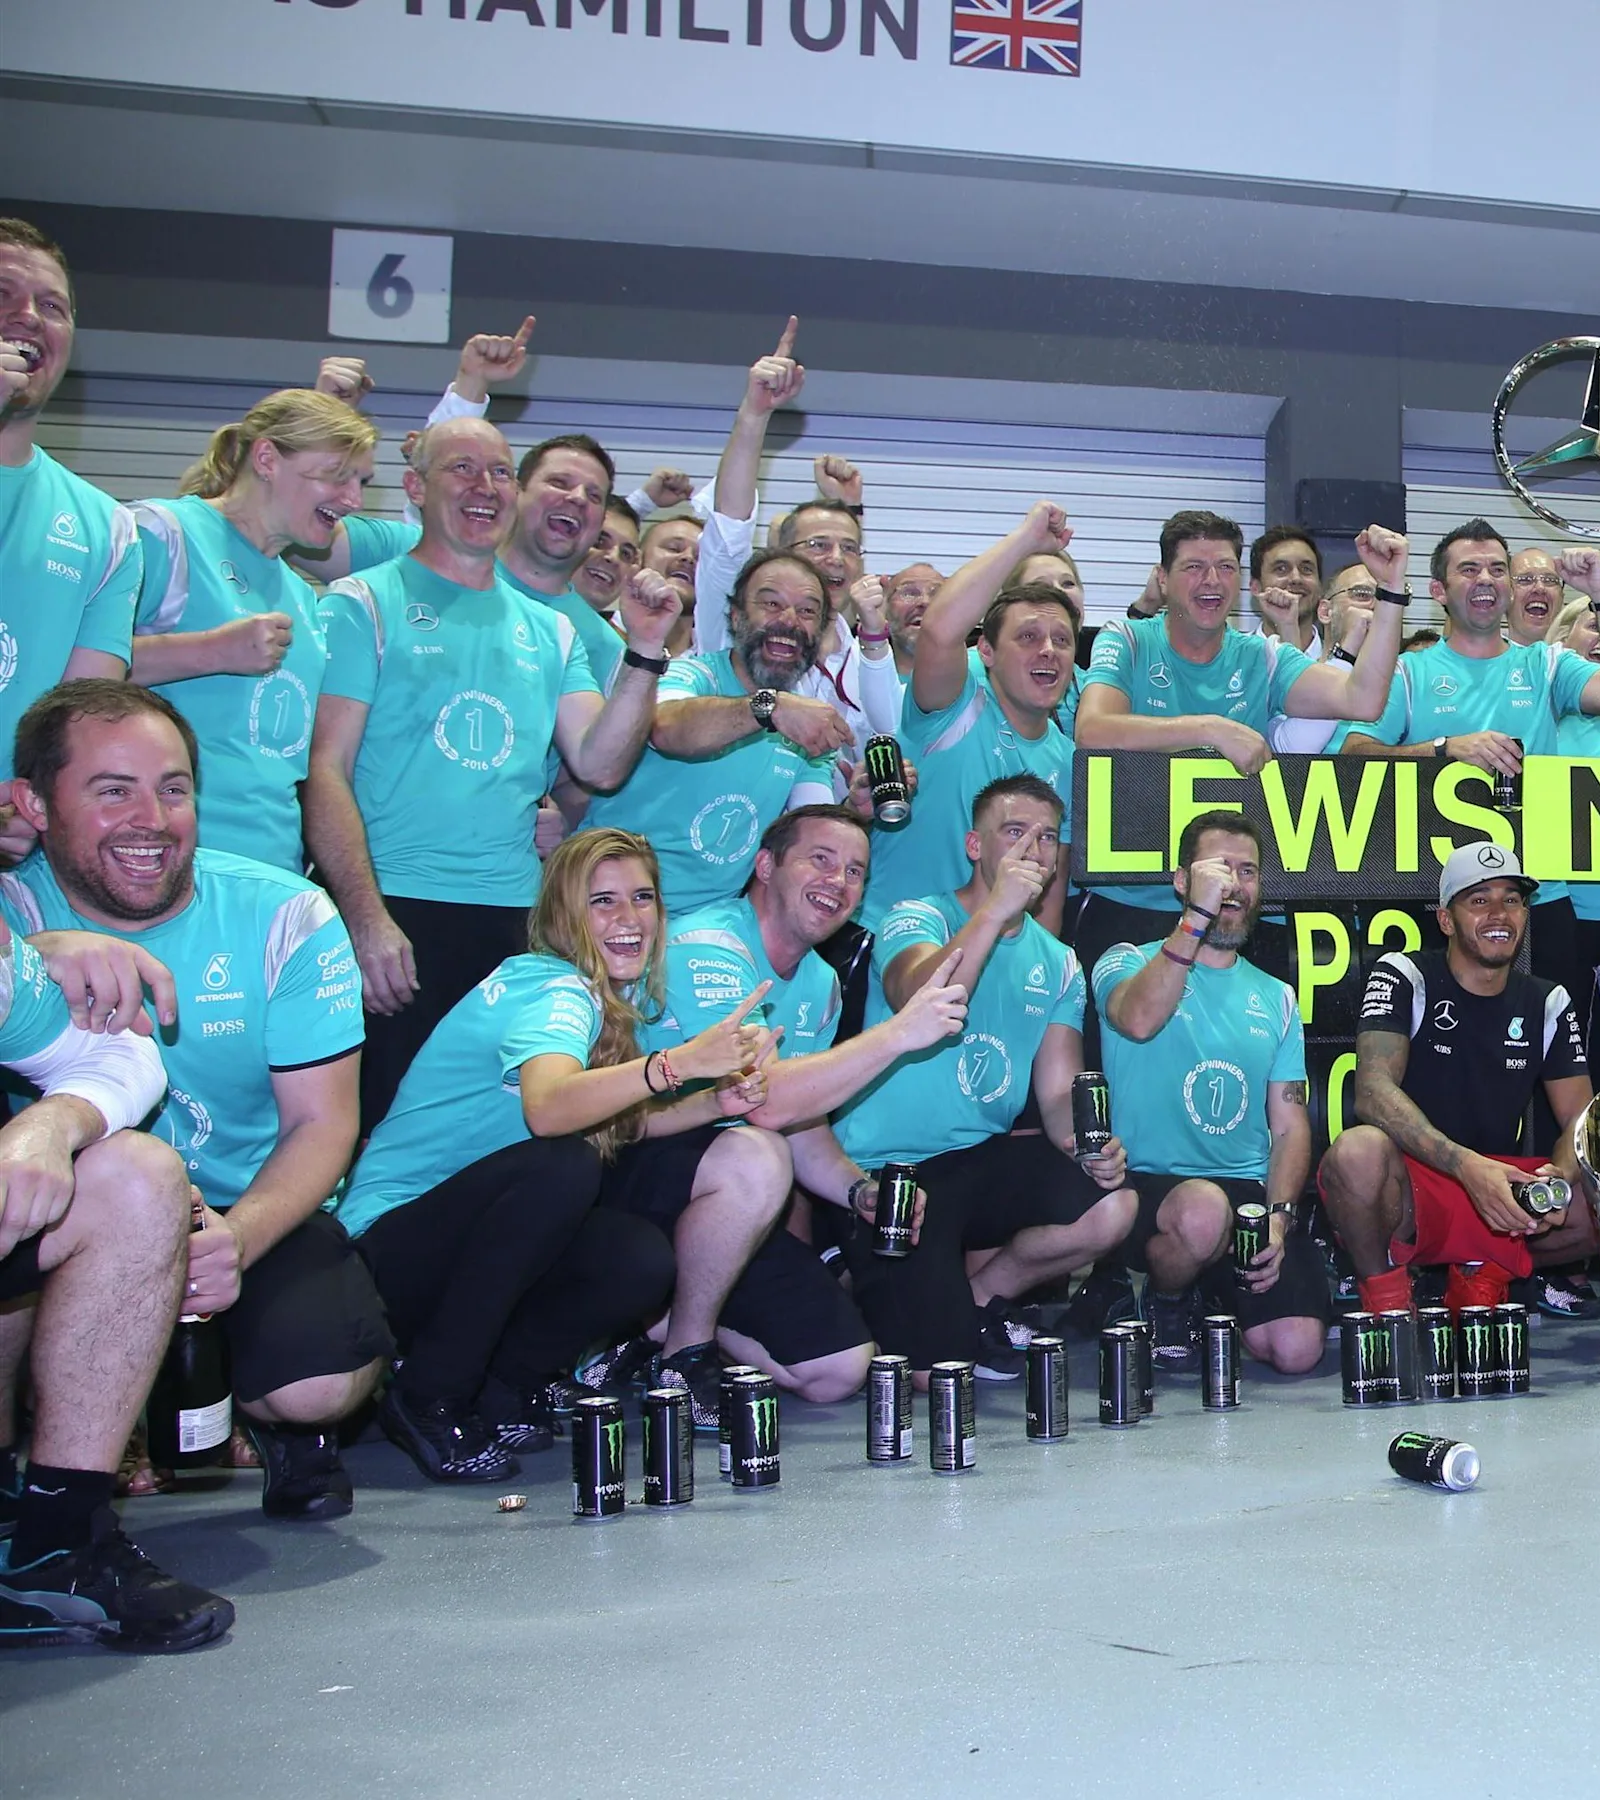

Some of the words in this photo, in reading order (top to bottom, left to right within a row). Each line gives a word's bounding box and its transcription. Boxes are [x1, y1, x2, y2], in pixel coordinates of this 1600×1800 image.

[404, 0, 917, 61] LTON
[367, 253, 414, 319] 6
[47, 559, 83, 581] BOSS
[1512, 700, 1533, 708] BOSS
[464, 708, 483, 752] 1
[461, 757, 489, 771] 2016
[1495, 786, 1514, 794] STER
[716, 808, 742, 847] 1
[701, 850, 725, 866] 2016
[693, 973, 741, 988] EPSON
[195, 991, 245, 1003] PETRONAS
[1024, 1004, 1046, 1014] BOSS
[202, 1019, 246, 1034] BOSS
[1249, 1026, 1269, 1037] BOSS
[964, 1034, 978, 1045] GP
[1437, 1044, 1452, 1054] UBS
[1506, 1058, 1527, 1066] BOSS
[1195, 1060, 1207, 1073] GP
[1206, 1059, 1246, 1082] WINNERS
[1208, 1076, 1224, 1117] 1
[1085, 1129, 1112, 1139] MONS
[1202, 1123, 1227, 1136] 2016
[1425, 1373, 1453, 1383] MONST
[741, 1455, 780, 1468] MONSTE
[595, 1482, 625, 1495] MONS
